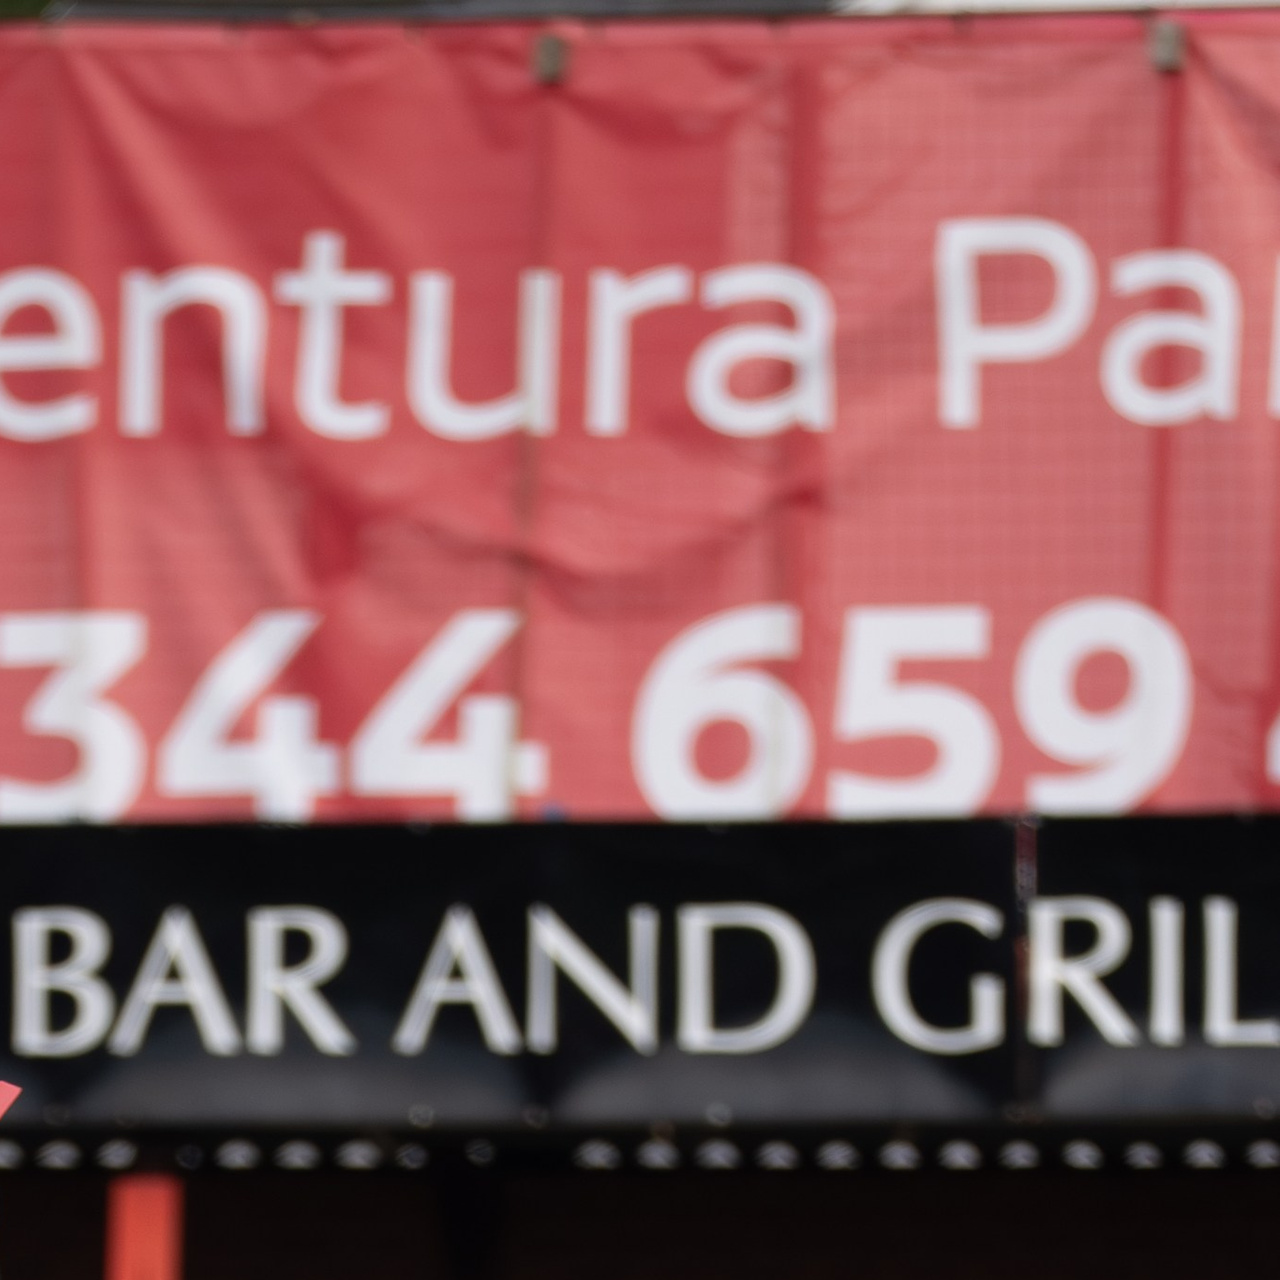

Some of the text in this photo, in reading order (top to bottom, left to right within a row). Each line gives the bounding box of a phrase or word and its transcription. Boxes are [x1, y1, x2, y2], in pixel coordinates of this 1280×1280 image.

[630, 596, 1195, 822] 659
[11, 905, 355, 1058] BAR
[392, 903, 818, 1056] AND
[871, 895, 1280, 1055] GRIL
